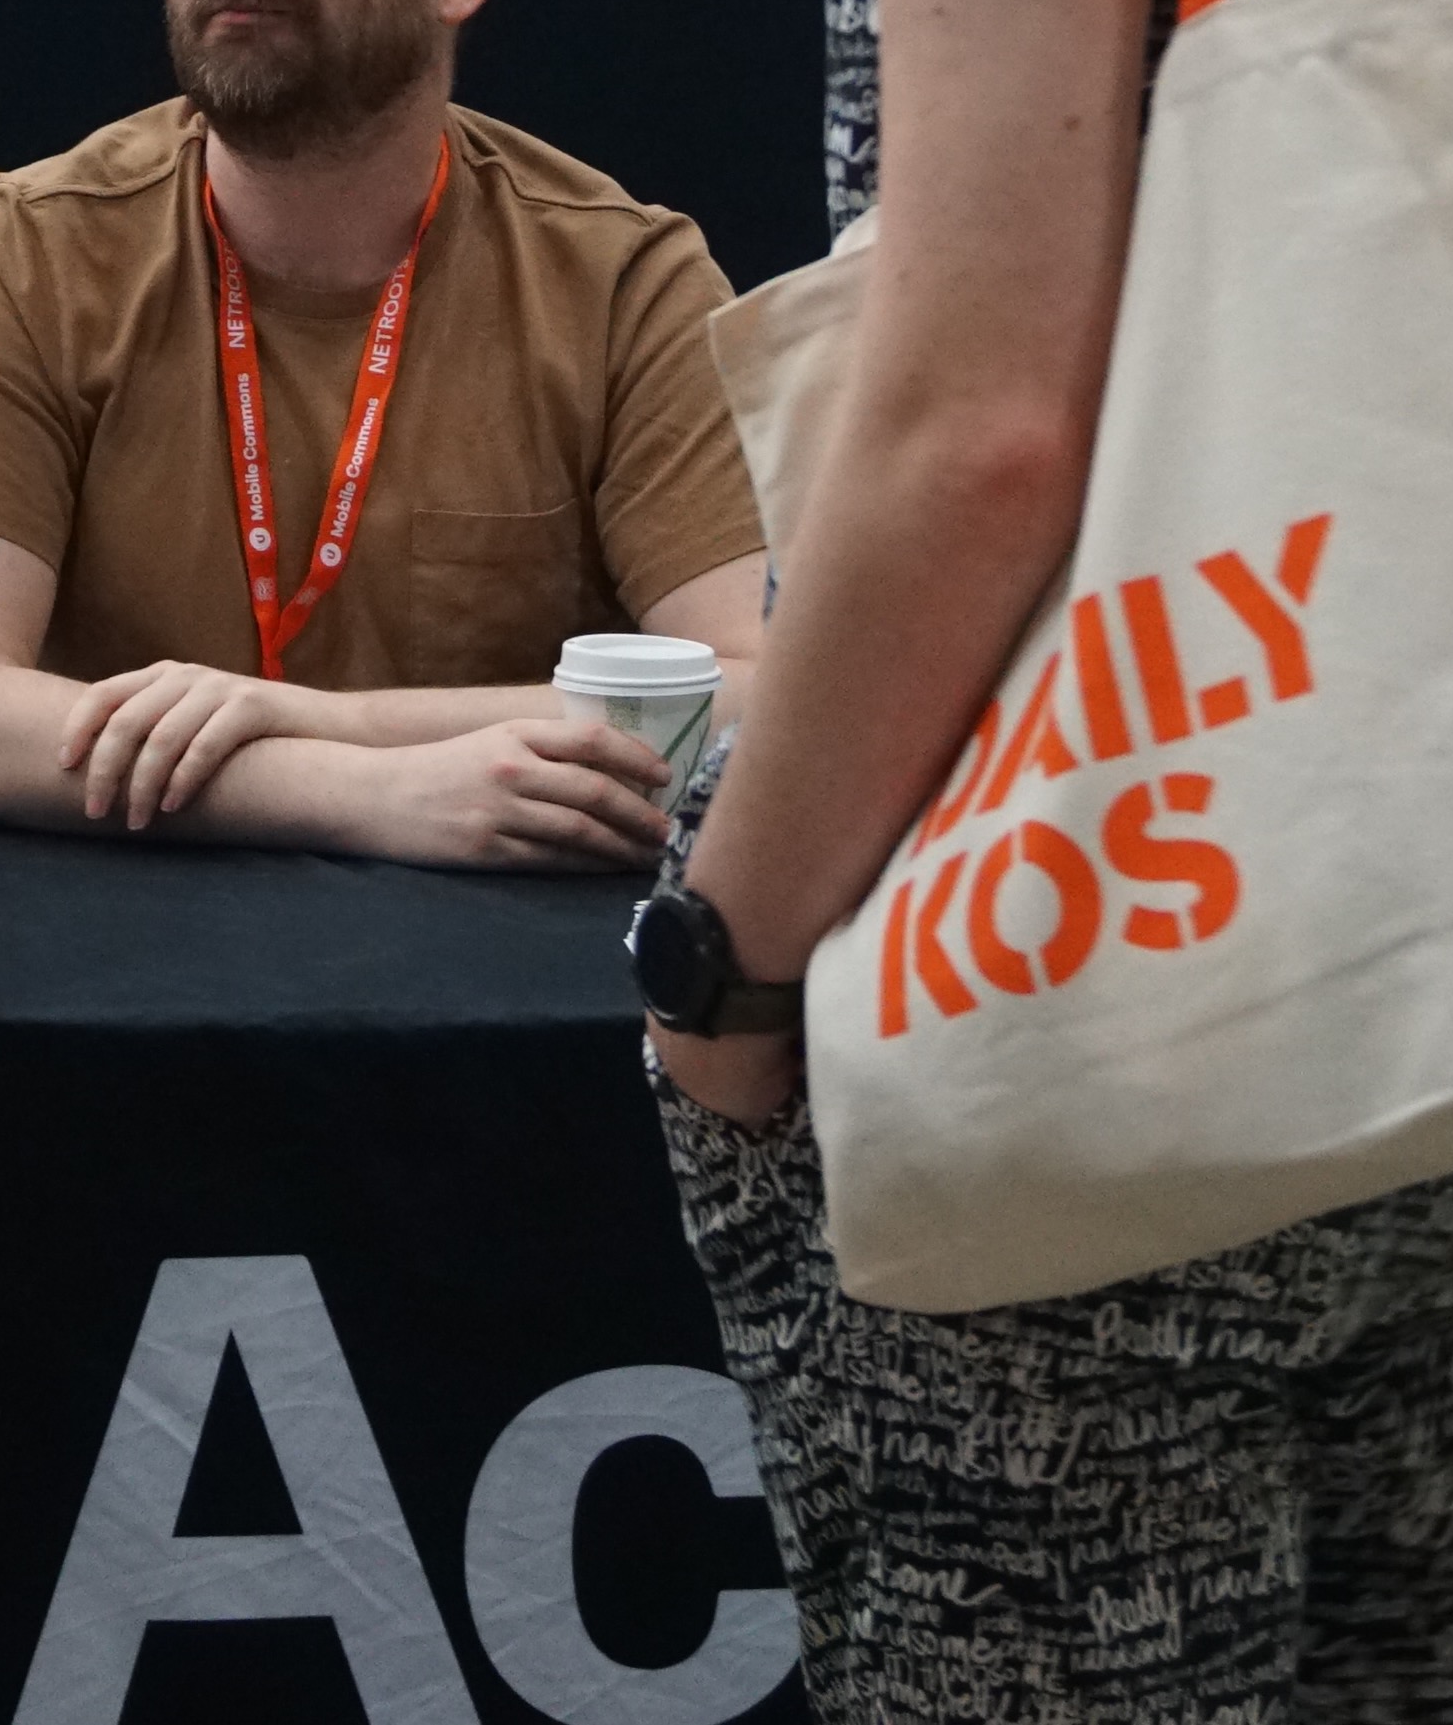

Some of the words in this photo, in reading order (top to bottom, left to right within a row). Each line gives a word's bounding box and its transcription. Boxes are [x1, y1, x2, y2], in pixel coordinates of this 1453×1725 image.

[237, 372, 258, 461] Commons
[329, 480, 357, 538] Mobile
[345, 397, 380, 479] Commons
[244, 463, 265, 521] Mobile
[878, 772, 1242, 1040] KOS
